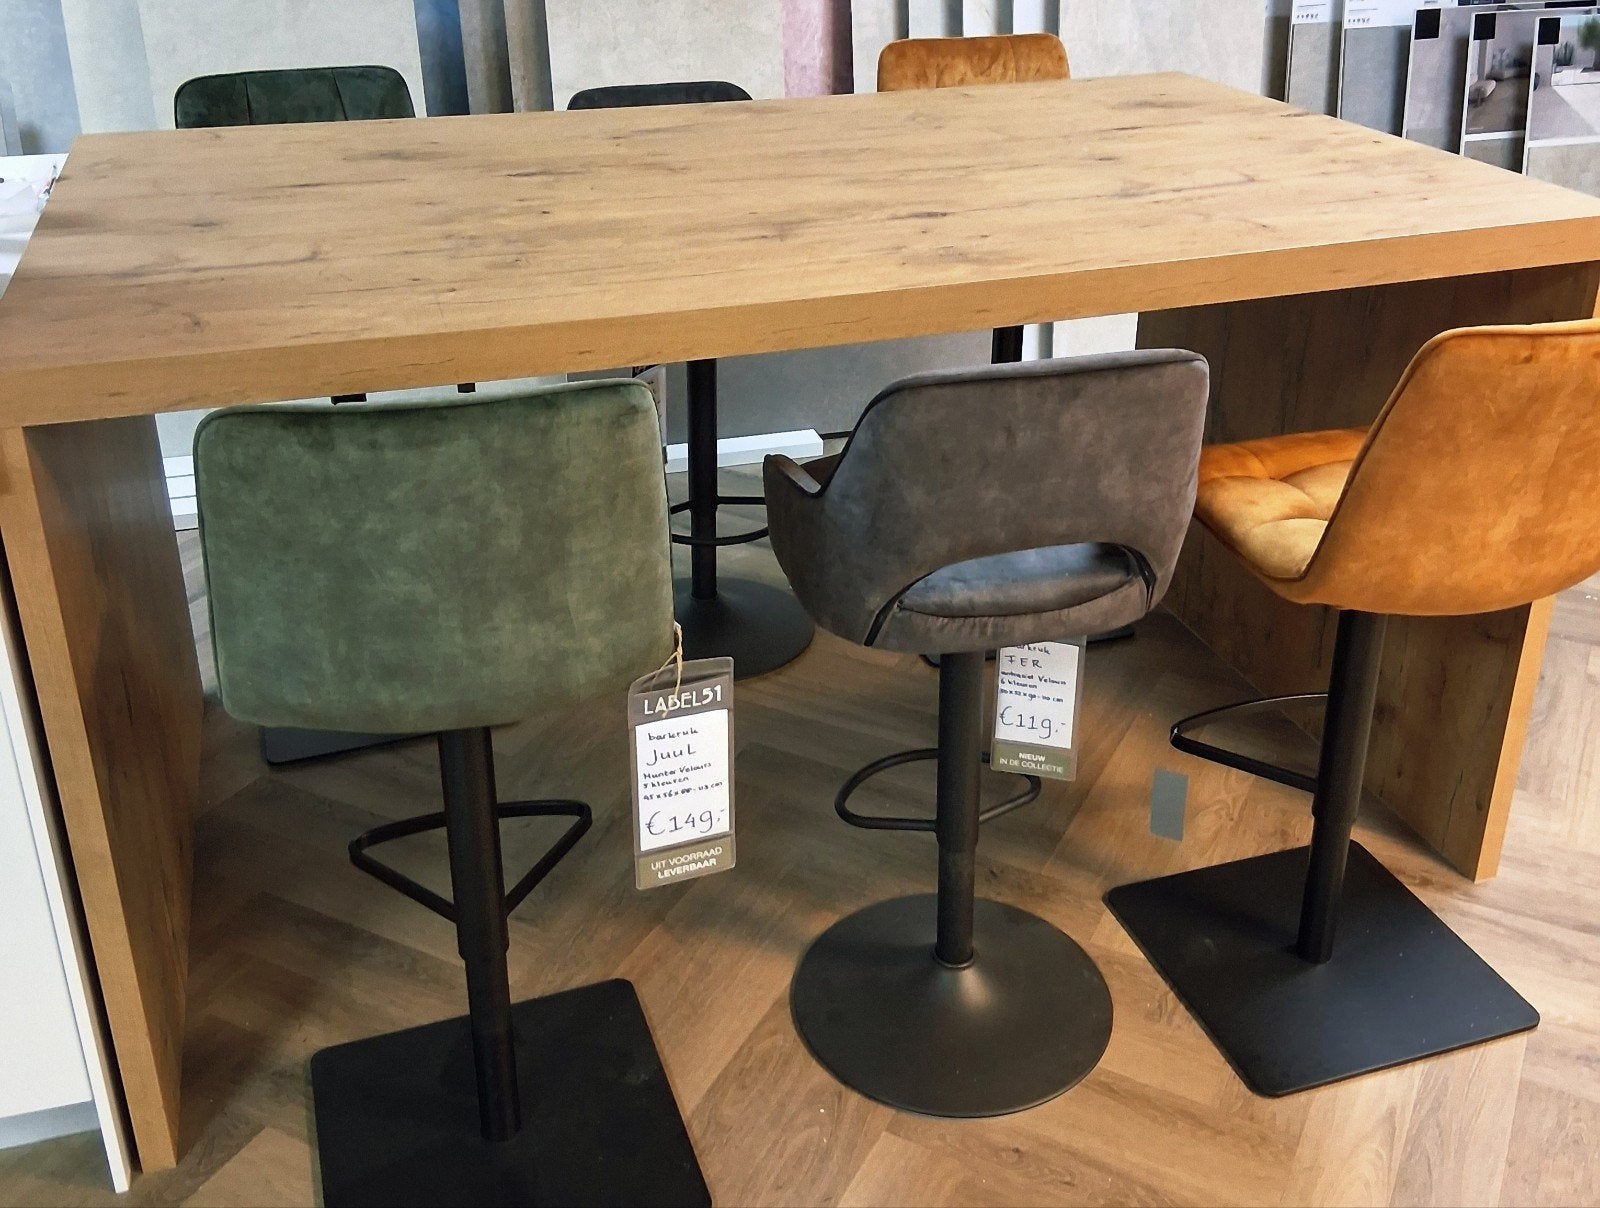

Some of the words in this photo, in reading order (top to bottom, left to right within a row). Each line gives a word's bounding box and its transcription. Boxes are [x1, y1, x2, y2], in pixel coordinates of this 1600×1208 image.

[644, 684, 722, 715] LABEL51
[647, 727, 699, 741] barkruk
[999, 757, 1008, 765] IN
[1009, 759, 1020, 767] DE
[1021, 761, 1064, 774] COLLECTIE
[1018, 752, 1046, 762] NIEUW
[650, 859, 667, 871] UIT
[668, 846, 723, 866] VOORRAAD
[657, 857, 717, 879] LEVERBAAR
